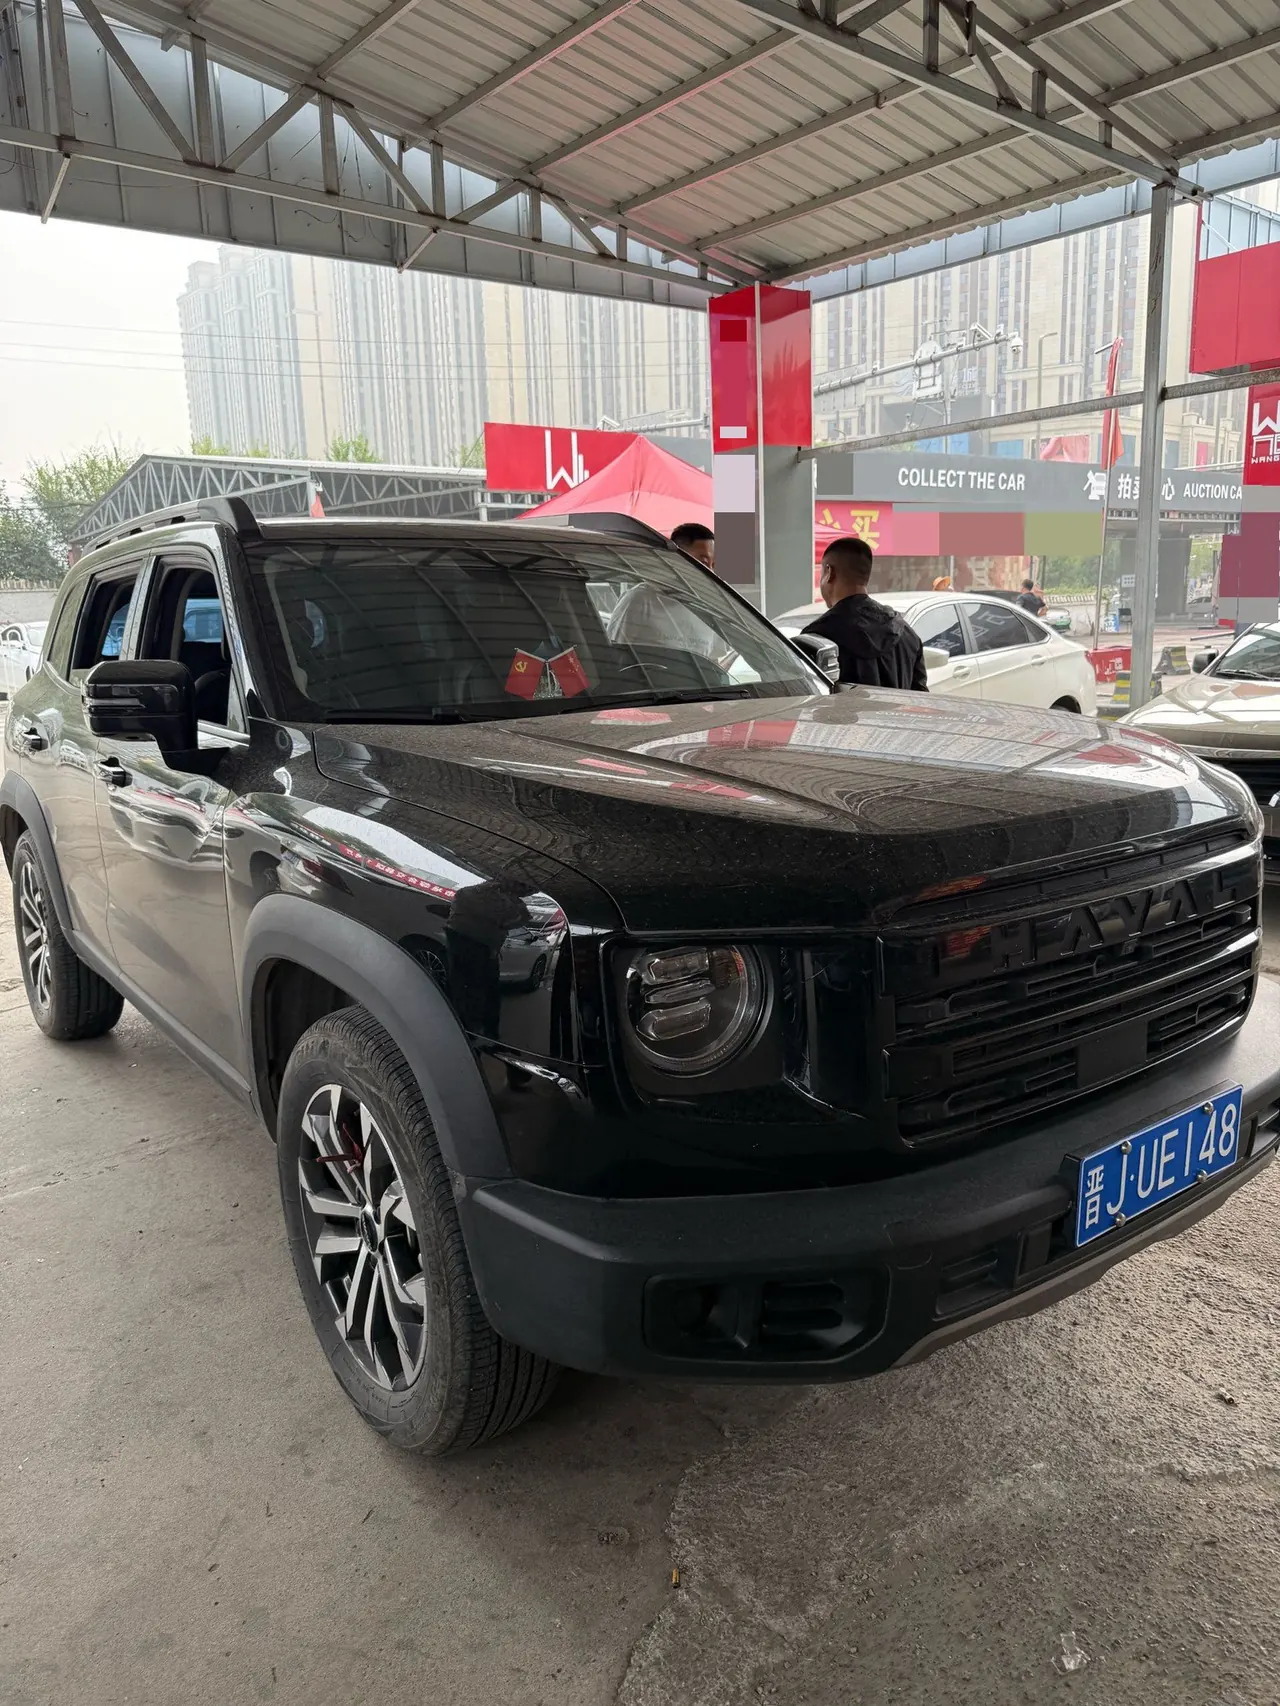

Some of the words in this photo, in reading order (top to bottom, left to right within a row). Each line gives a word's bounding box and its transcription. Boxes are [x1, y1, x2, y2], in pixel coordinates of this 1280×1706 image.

[898, 467, 965, 488] COLLECT
[968, 471, 995, 490] THE
[998, 473, 1025, 491] CAR
[1183, 483, 1228, 499] AUCTION
[1229, 485, 1242, 500] CA
[989, 870, 1236, 973] HAVAL
